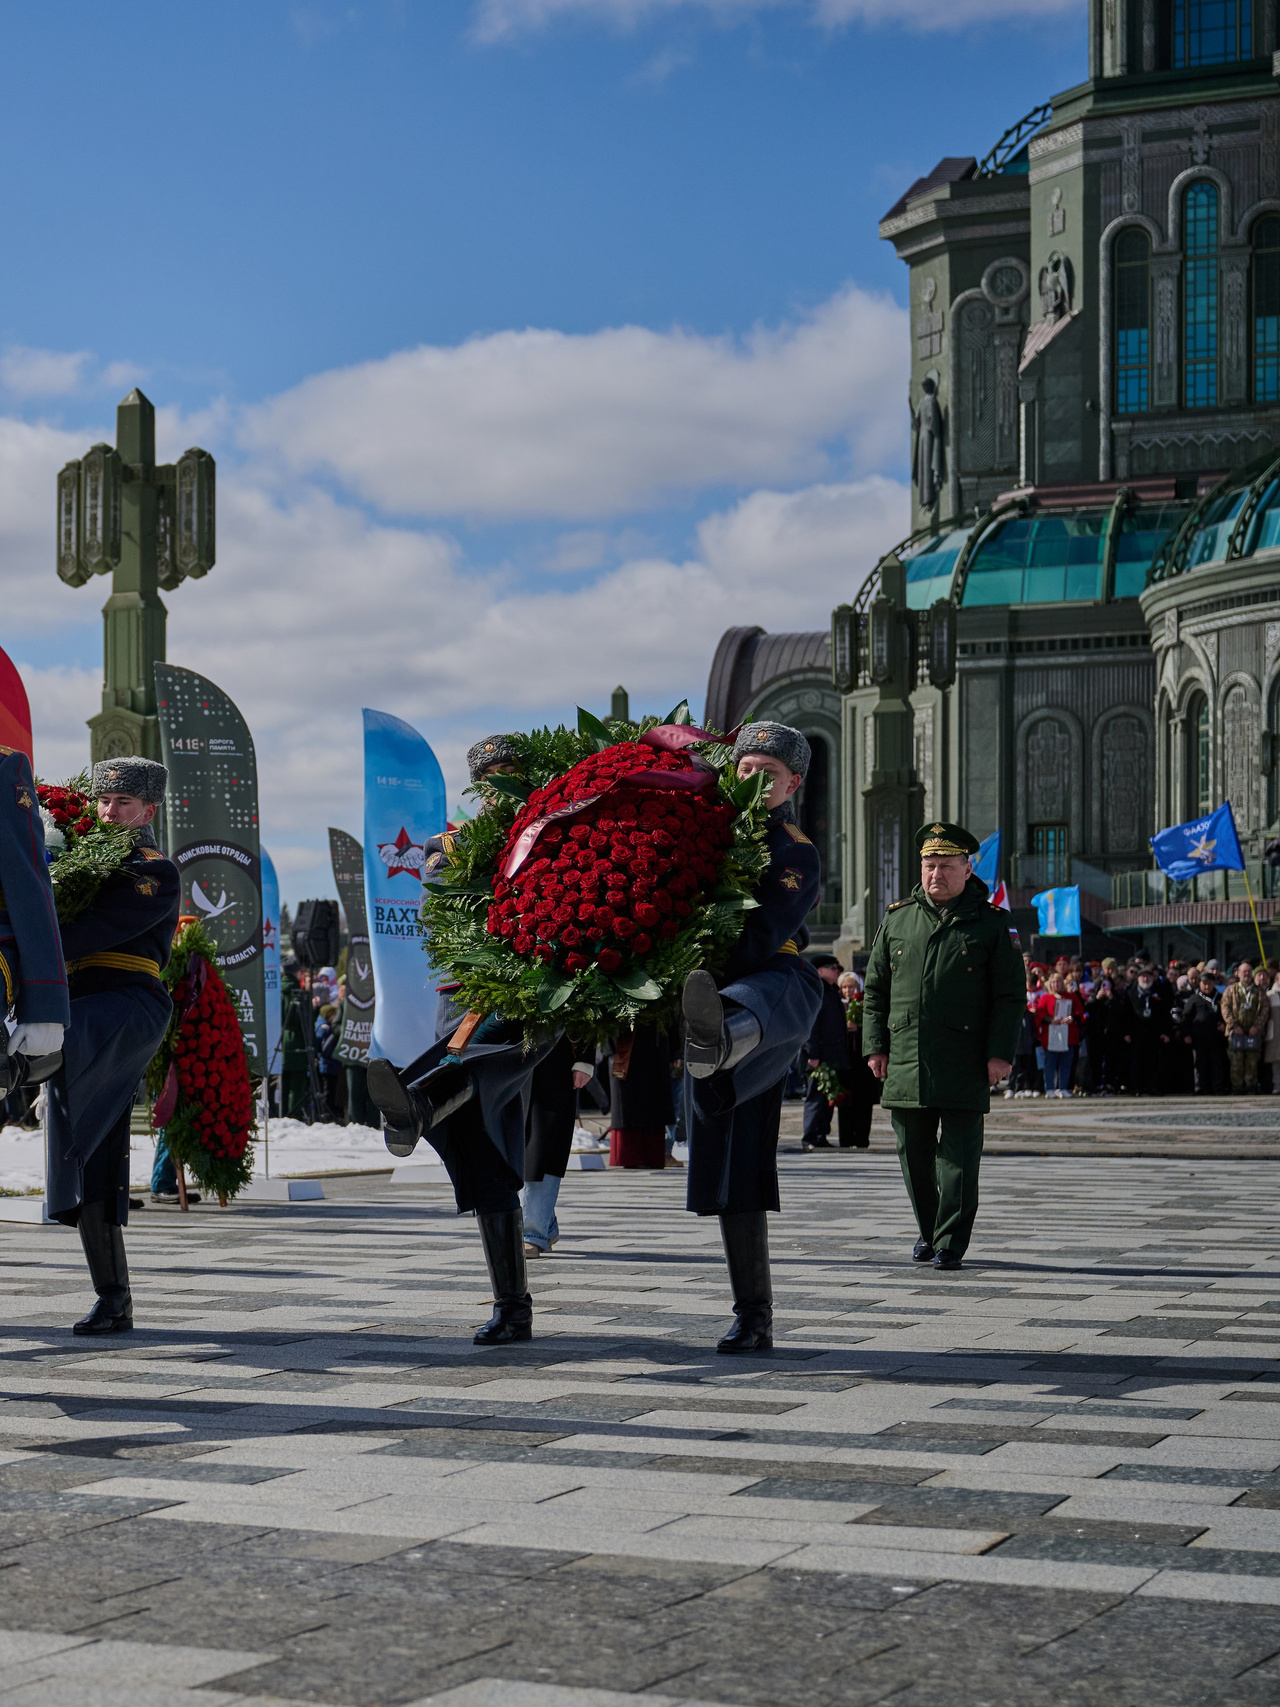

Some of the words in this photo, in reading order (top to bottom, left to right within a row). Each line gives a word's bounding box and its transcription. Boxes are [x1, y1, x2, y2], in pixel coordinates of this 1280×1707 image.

[177, 845, 221, 864] ПОИСКОВЫЕ
[221, 846, 252, 866] ОТРЯДЫ
[374, 906, 419, 923] ВАХТ
[226, 945, 257, 966] ОБЛАСТИ
[338, 1044, 370, 1063] 202
